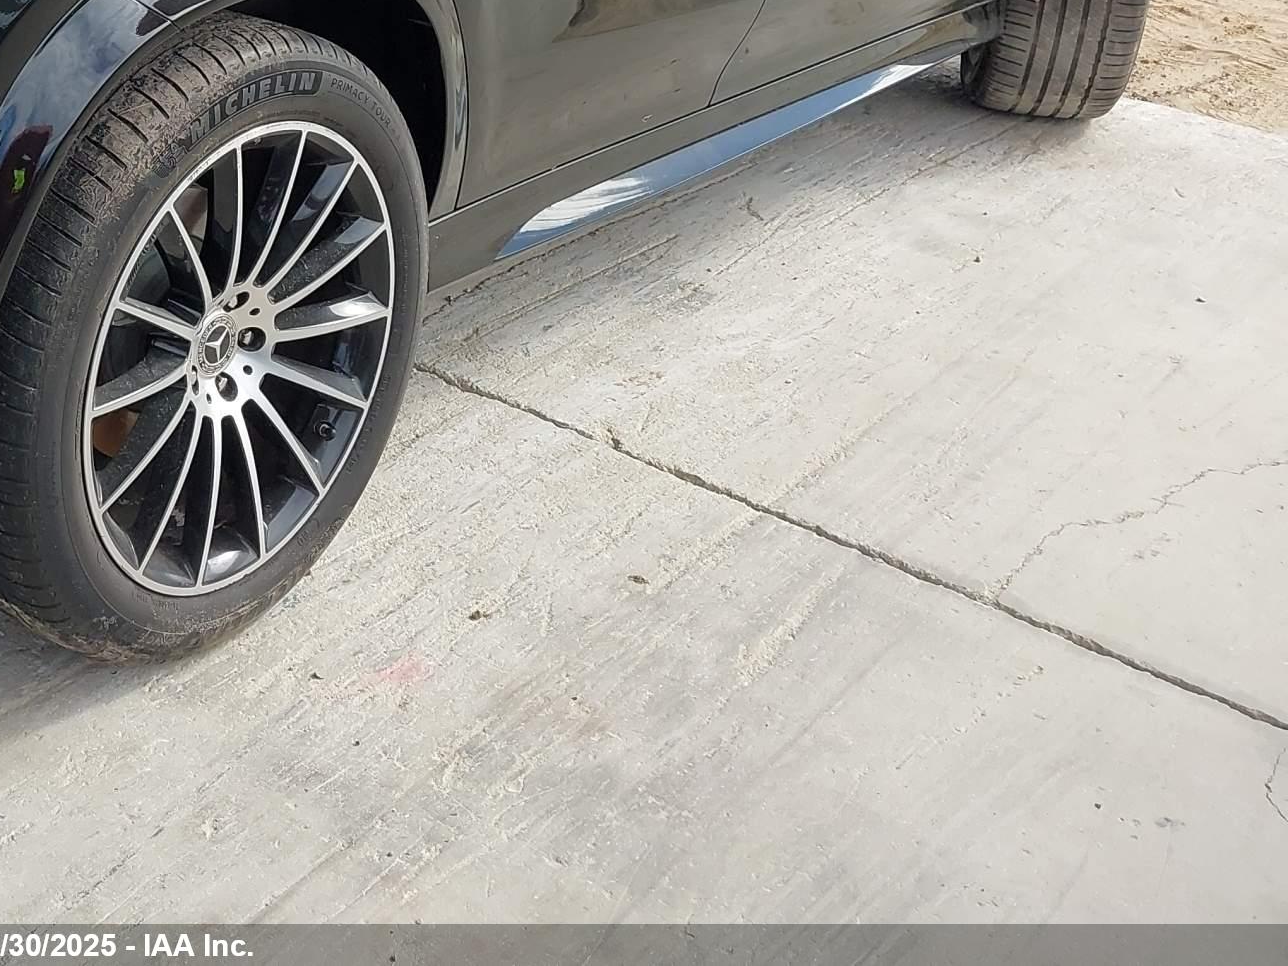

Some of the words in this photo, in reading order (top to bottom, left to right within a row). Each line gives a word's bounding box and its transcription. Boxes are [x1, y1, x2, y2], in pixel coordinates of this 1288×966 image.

[190, 72, 317, 143] MICHELIN
[330, 77, 371, 104] PRIMACY
[371, 101, 391, 127] TOUR
